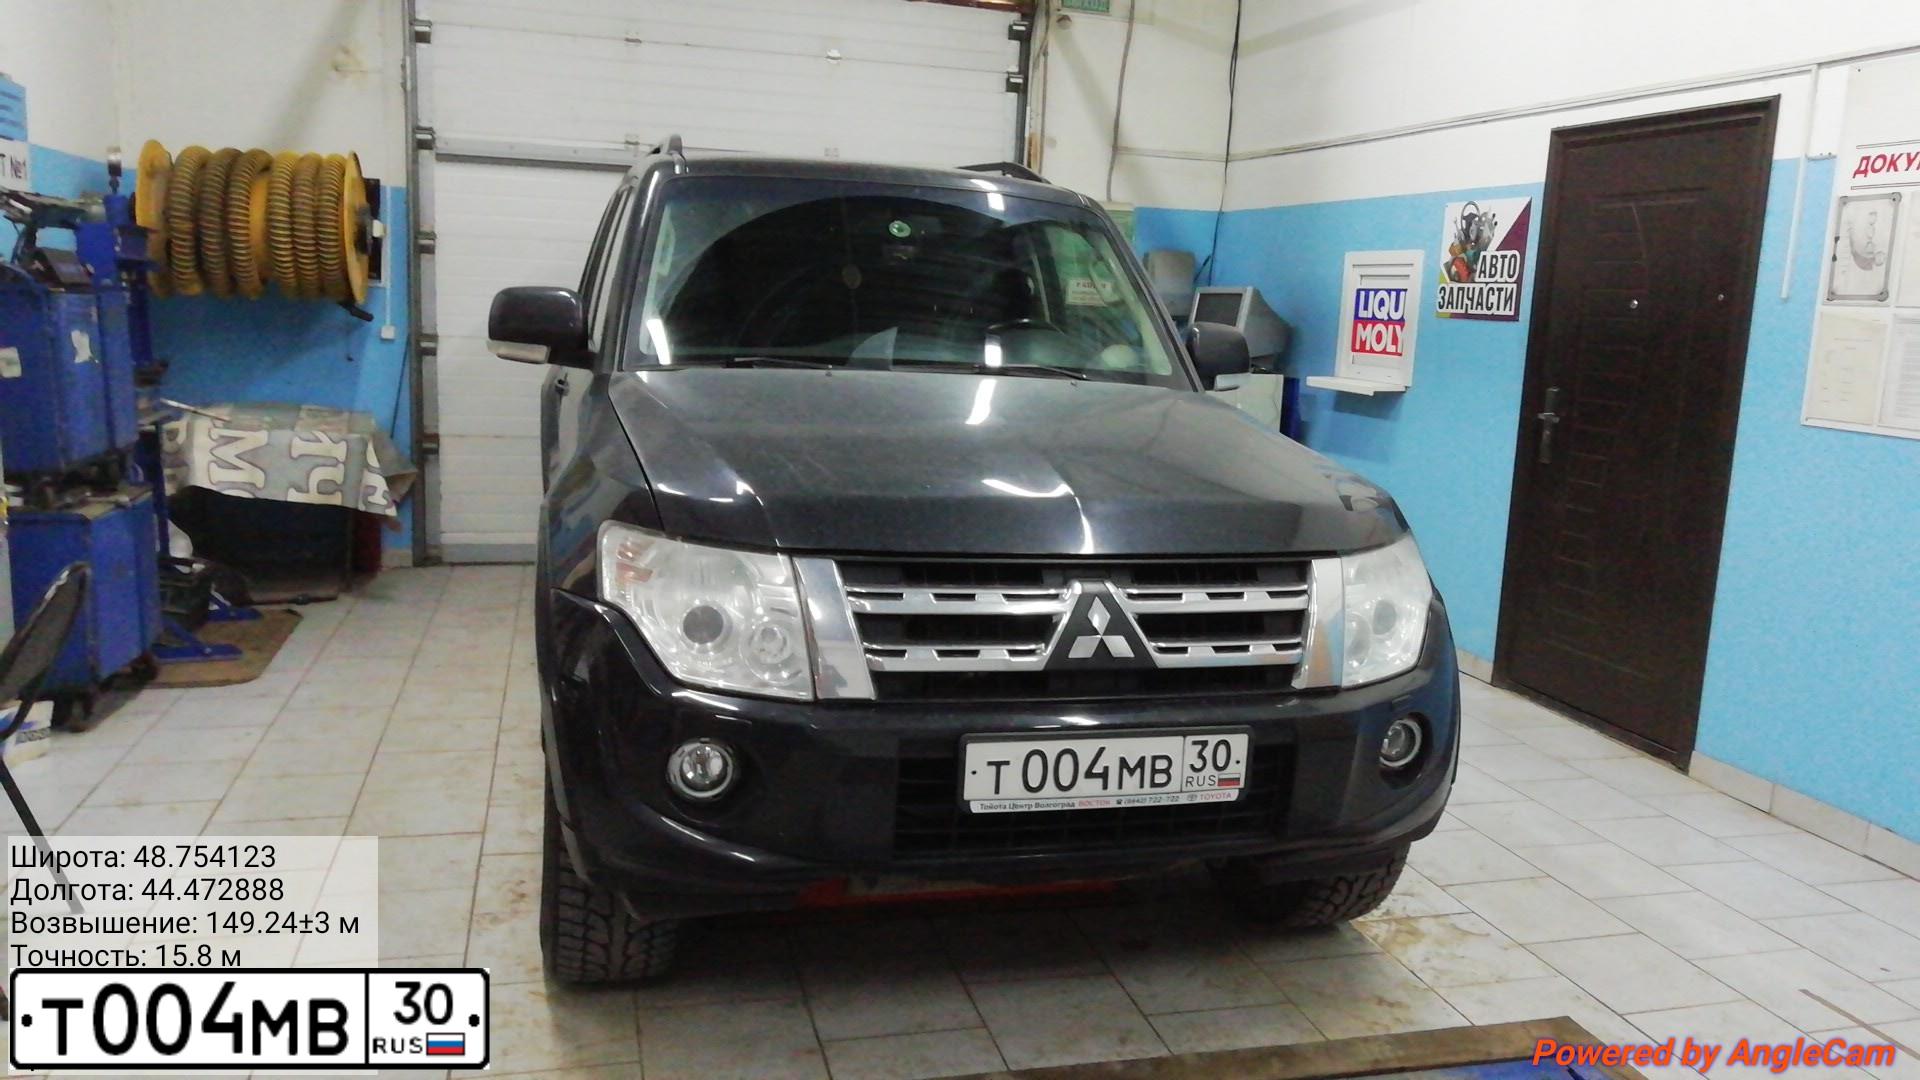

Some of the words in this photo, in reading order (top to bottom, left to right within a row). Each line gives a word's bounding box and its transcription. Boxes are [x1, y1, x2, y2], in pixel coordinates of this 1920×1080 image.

[1852, 151, 1920, 178] ДОКУ
[1478, 253, 1518, 279] АВТО
[1358, 289, 1407, 320] LIQU
[1438, 286, 1515, 312] ЗАПЧАСТИ
[1355, 323, 1403, 353] MOLY
[1189, 739, 1232, 773] 30
[1185, 774, 1217, 788] RUS
[1199, 792, 1232, 801] TOYOTA
